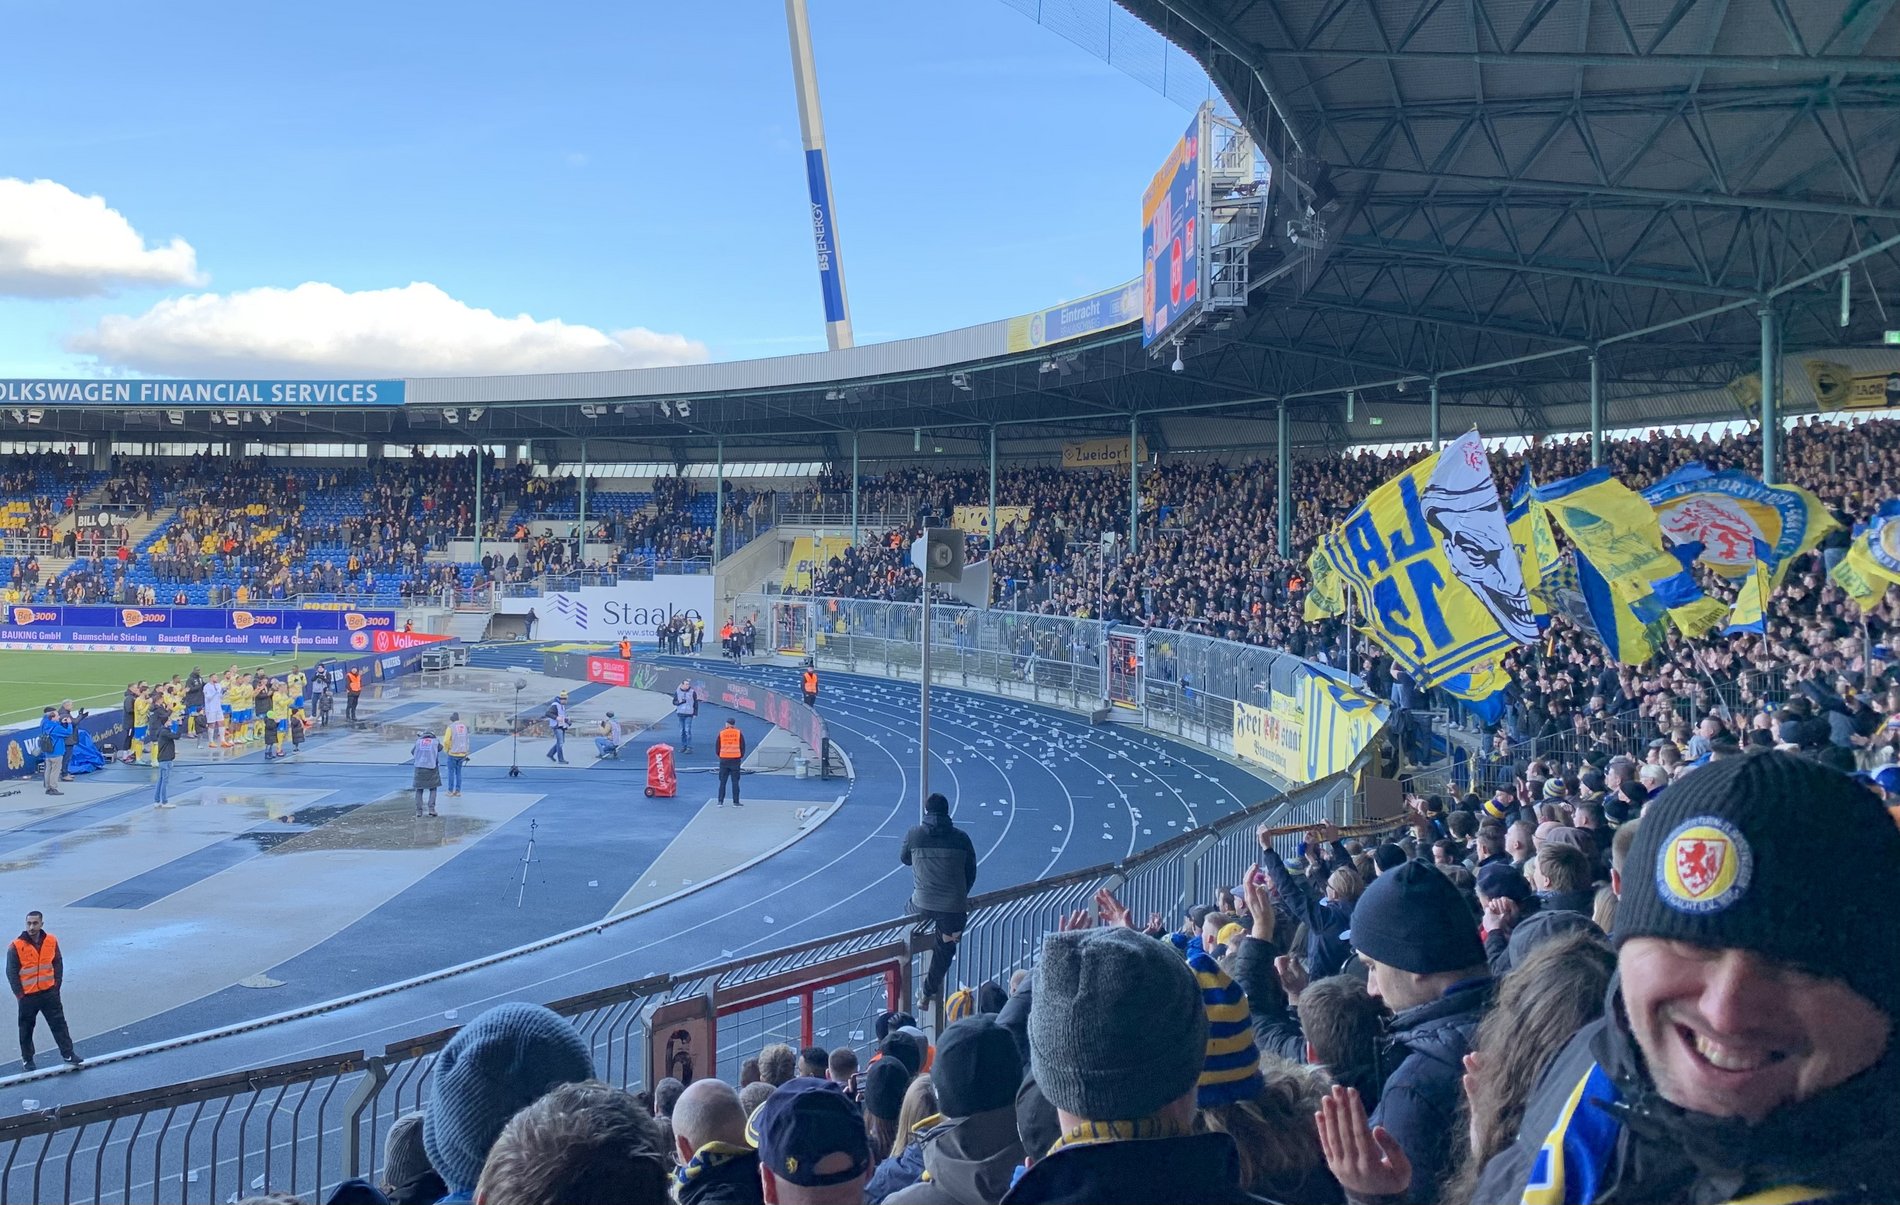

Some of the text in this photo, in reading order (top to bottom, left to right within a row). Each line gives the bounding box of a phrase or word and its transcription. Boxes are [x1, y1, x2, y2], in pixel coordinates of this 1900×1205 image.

[1061, 301, 1100, 324] Eintracht
[141, 383, 262, 402] FINANCIAL
[271, 384, 378, 402] SERVICES
[1076, 444, 1129, 462] Zweidorf
[78, 515, 97, 527] BILL
[303, 602, 356, 610] SOCIETY
[603, 601, 700, 625] Staake
[2, 631, 62, 640] BAUKING GmbH
[72, 632, 147, 642] Baumschule Stielau
[158, 634, 248, 644] Baustoff Brandes GmbH
[260, 635, 280, 644] Wolff
[282, 636, 289, 644] &
[315, 636, 338, 645] GmbH
[665, 1030, 694, 1083] 6
